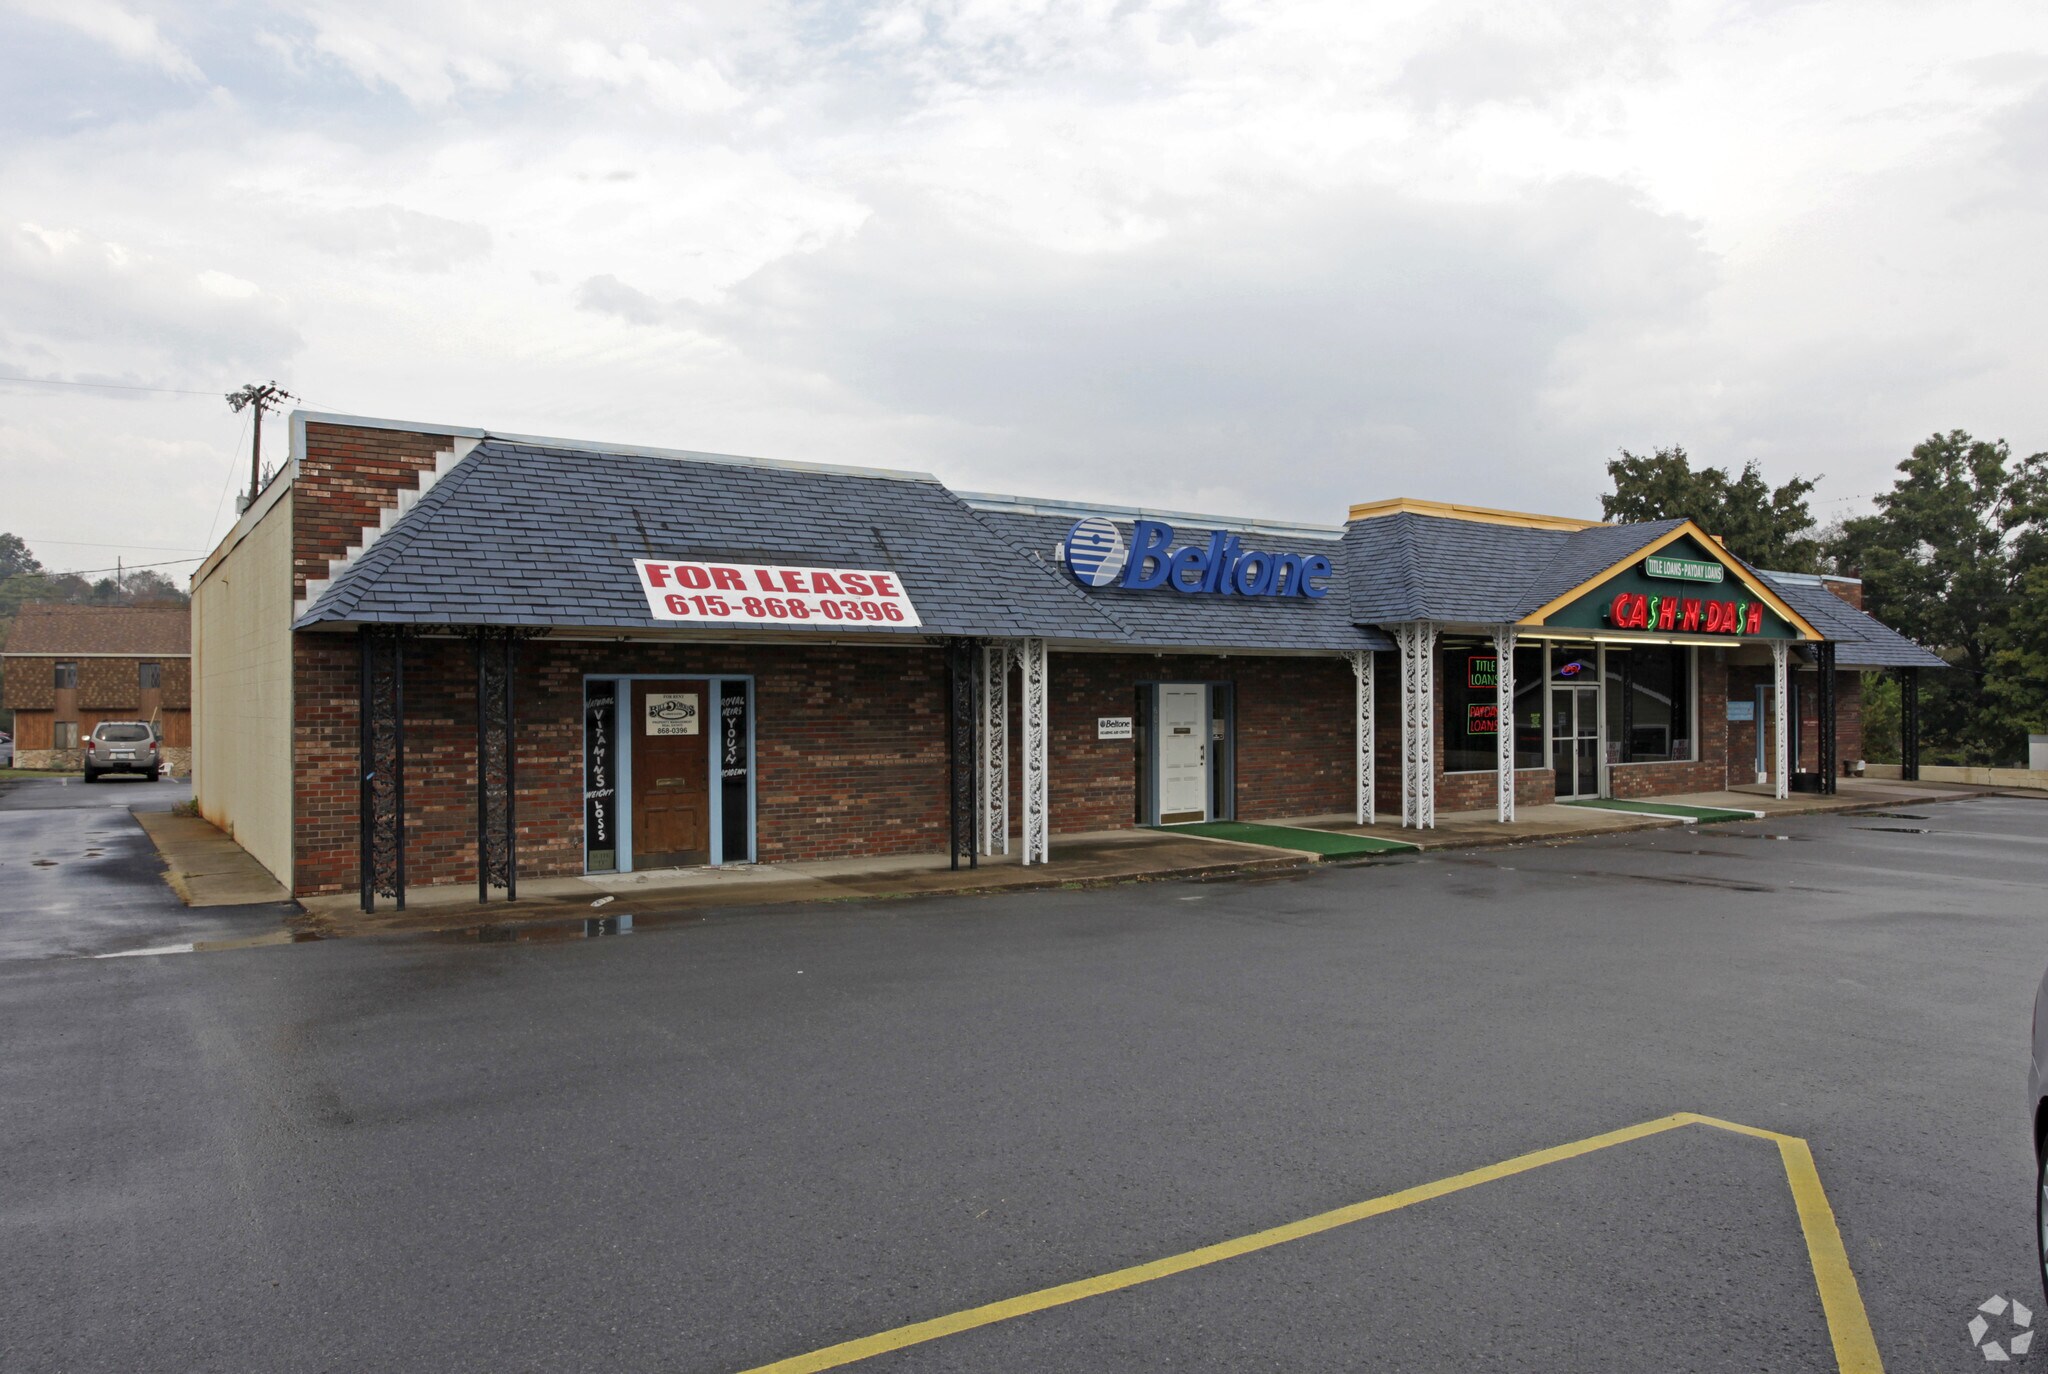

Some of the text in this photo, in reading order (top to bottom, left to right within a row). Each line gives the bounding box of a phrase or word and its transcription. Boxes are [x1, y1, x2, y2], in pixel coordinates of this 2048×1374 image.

[1118, 520, 1333, 598] Beltone
[1649, 559, 1662, 574] TITLE
[1704, 565, 1721, 580] LOANS
[644, 563, 900, 598] FOR LEASE
[664, 594, 904, 622] 615-868-0396
[1476, 660, 1496, 672] TITLE
[721, 696, 745, 706] ROYAL
[722, 706, 743, 717] HEIRS
[1106, 719, 1130, 728] Beltone
[594, 709, 606, 788] VITAMINS
[726, 717, 737, 765] YOUTH
[587, 788, 614, 799] WEIGHT
[594, 800, 606, 841] LOSS
